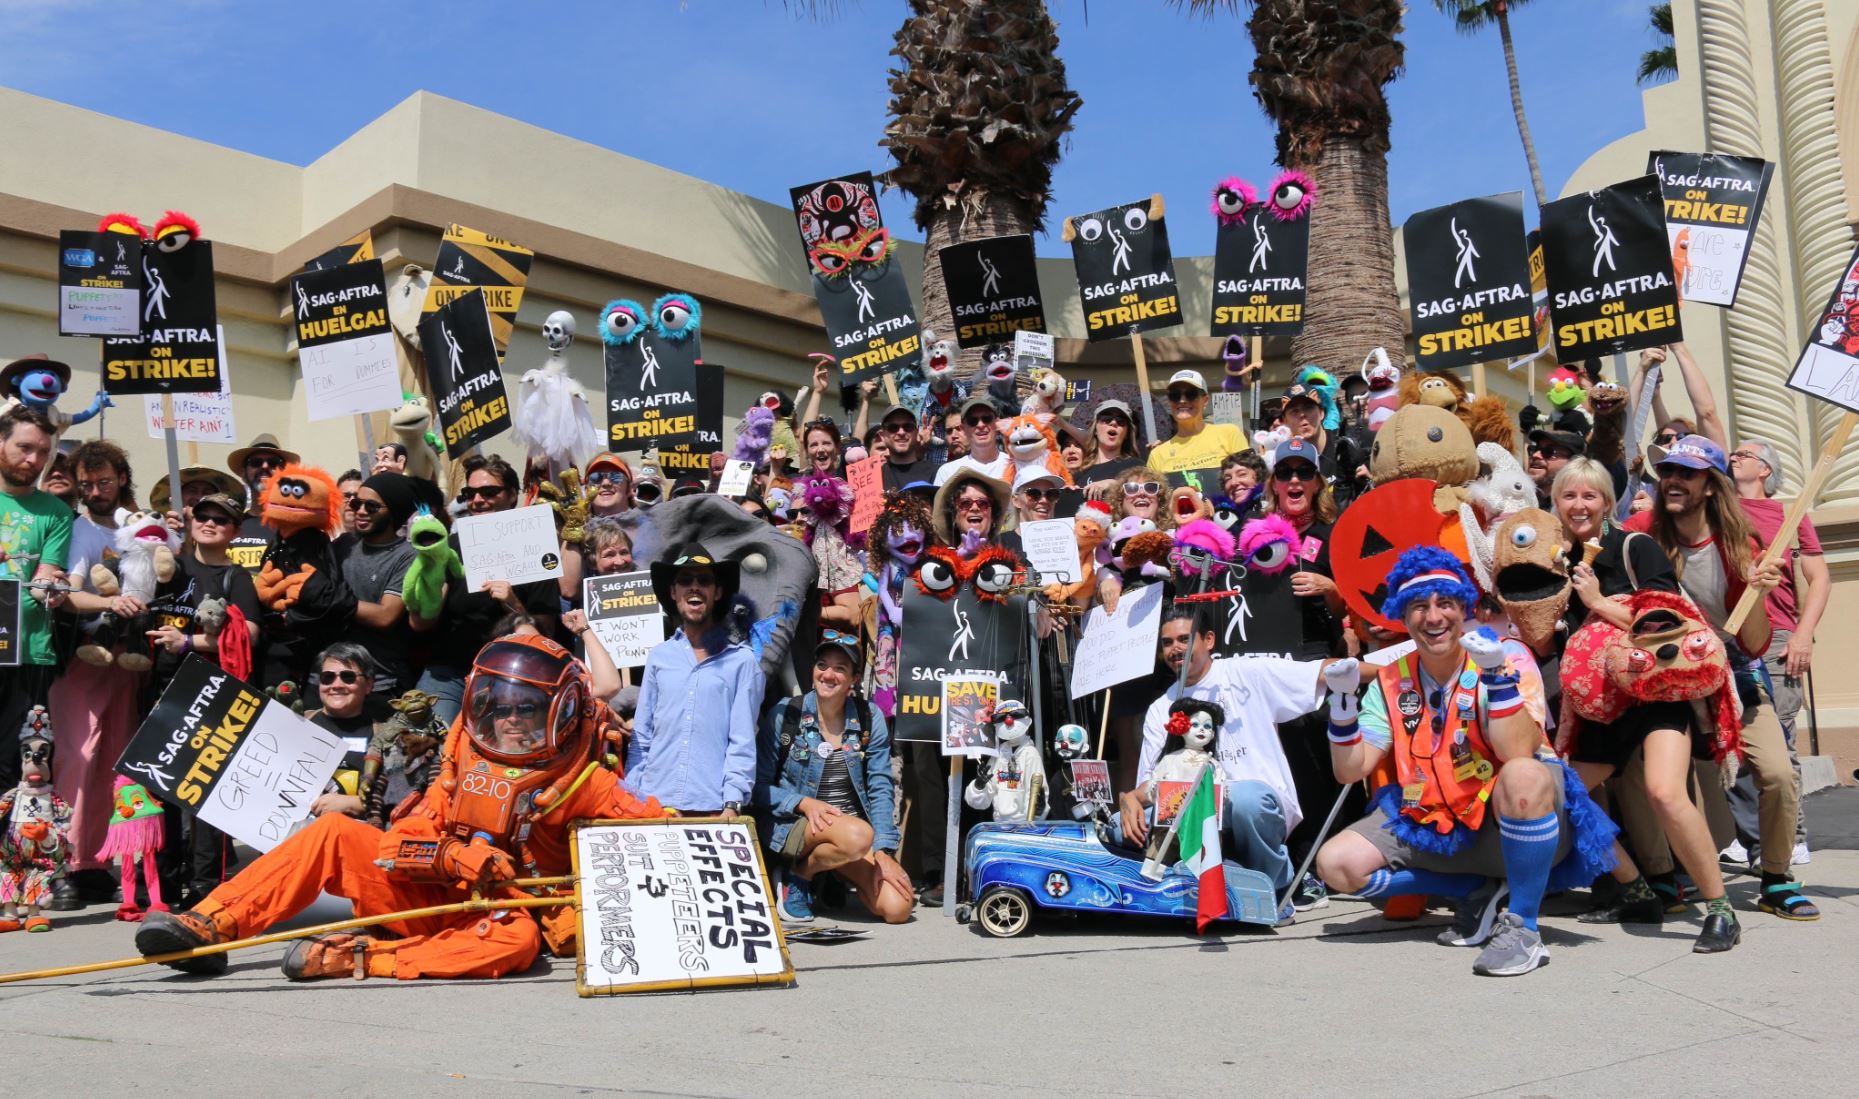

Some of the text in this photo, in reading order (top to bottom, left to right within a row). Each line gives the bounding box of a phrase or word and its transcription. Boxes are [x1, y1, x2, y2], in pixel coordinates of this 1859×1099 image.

[1685, 190, 1707, 200] ON
[1664, 200, 1748, 224] TRIKE!
[80, 279, 124, 288] STRIKE!
[333, 305, 347, 315] EN
[1120, 293, 1138, 305] ON
[1250, 294, 1268, 305] ON
[1600, 301, 1625, 315] ON
[300, 309, 386, 340] HUELGA!
[990, 312, 1008, 322] ON
[1088, 296, 1177, 330] STRIKE!
[1215, 304, 1302, 324] STRIKE!
[1461, 311, 1484, 325] ON
[959, 316, 1042, 340] STRIKE!
[1419, 315, 1531, 356] STRIKE!
[1558, 304, 1676, 347] STRIKE!
[151, 347, 172, 358] ON
[841, 335, 920, 374] STRIKE!
[869, 337, 886, 349] ON
[107, 358, 216, 381] STRIKE!
[174, 400, 226, 415] NREALISTIC
[460, 400, 475, 413] ON
[643, 409, 660, 419] ON
[446, 396, 508, 445] STRIKE!
[611, 415, 695, 441] STRIKE!
[602, 594, 657, 610] STRIKE!
[595, 622, 604, 632] I
[604, 632, 640, 643] WORK
[946, 681, 997, 700] SAVE
[176, 689, 261, 805] STRIKE!
[190, 725, 213, 750] ON
[218, 732, 279, 811] GREED
[259, 735, 340, 842] DOWNFALL
[462, 773, 511, 800] 82-10
[622, 831, 655, 870] SUIT
[684, 828, 739, 950] EFFECTS
[715, 830, 772, 964] SPECIAL
[587, 831, 640, 975] PERFORMERS
[653, 831, 710, 972] PUPPETEERS
